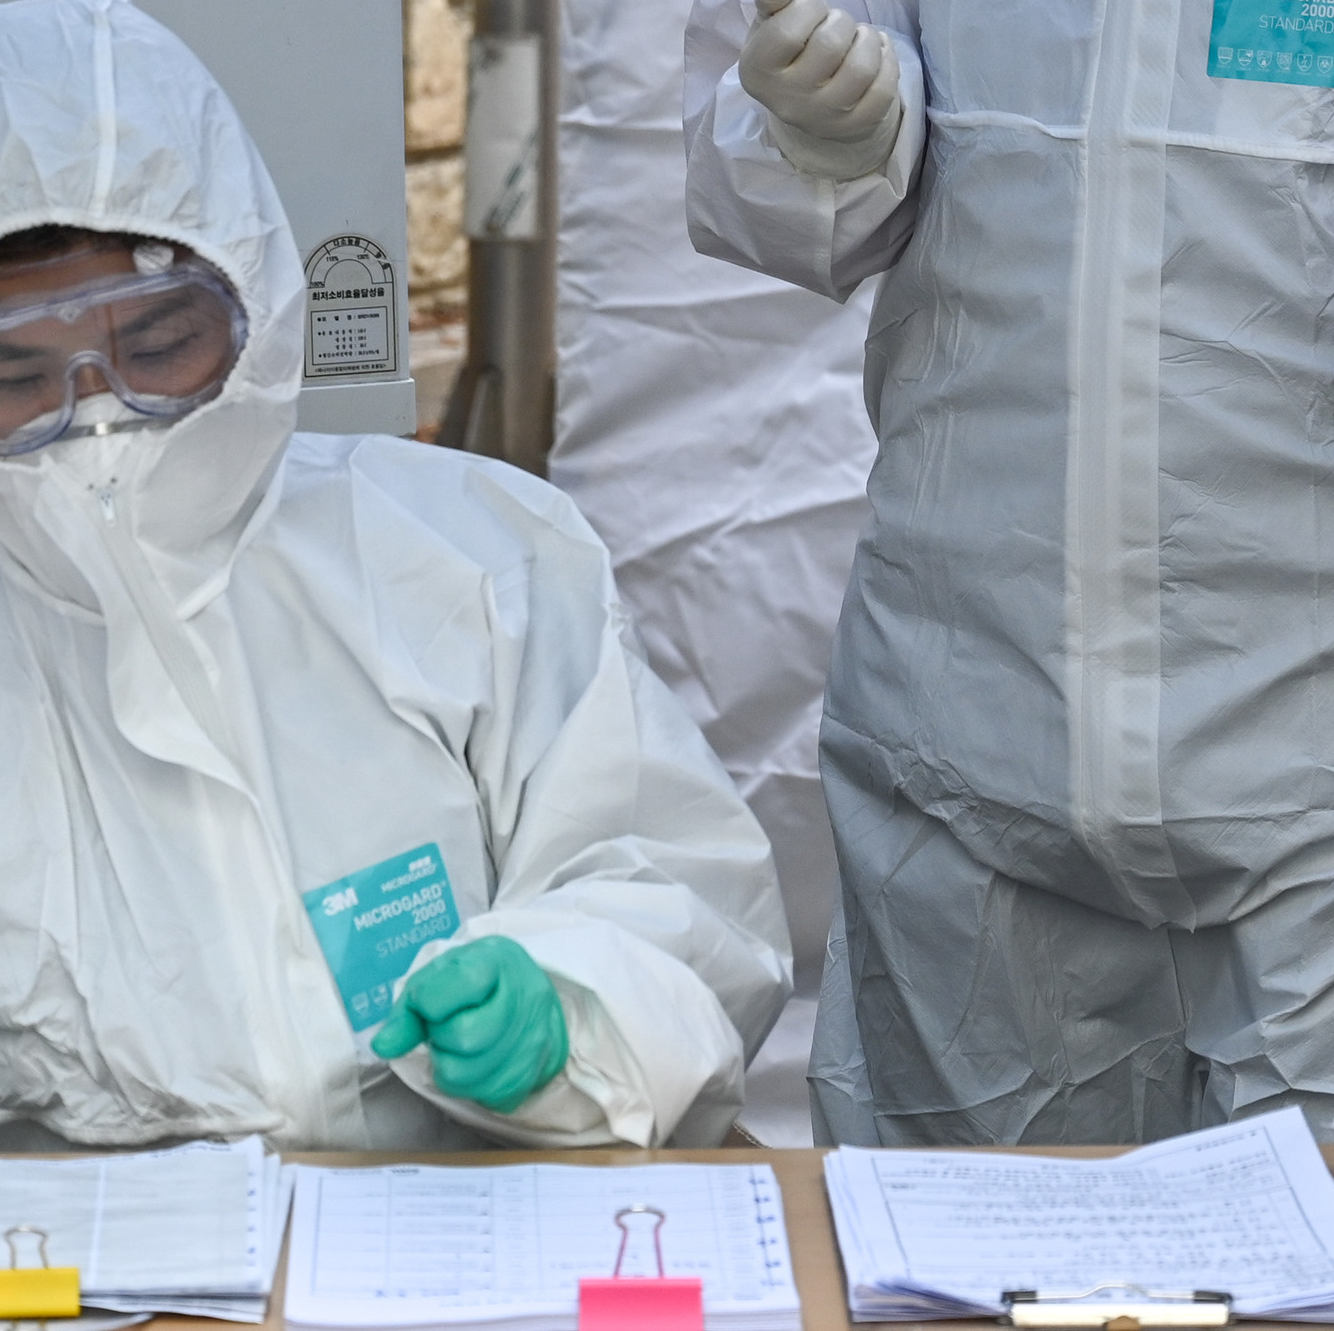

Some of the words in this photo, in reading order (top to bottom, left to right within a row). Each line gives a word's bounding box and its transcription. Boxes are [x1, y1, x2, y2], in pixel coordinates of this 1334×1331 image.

[1301, 4, 1334, 18] 2000
[1259, 15, 1334, 33] STANDARD
[322, 887, 359, 916] 3M
[412, 899, 446, 924] 2000
[375, 915, 451, 958] STANDARD
